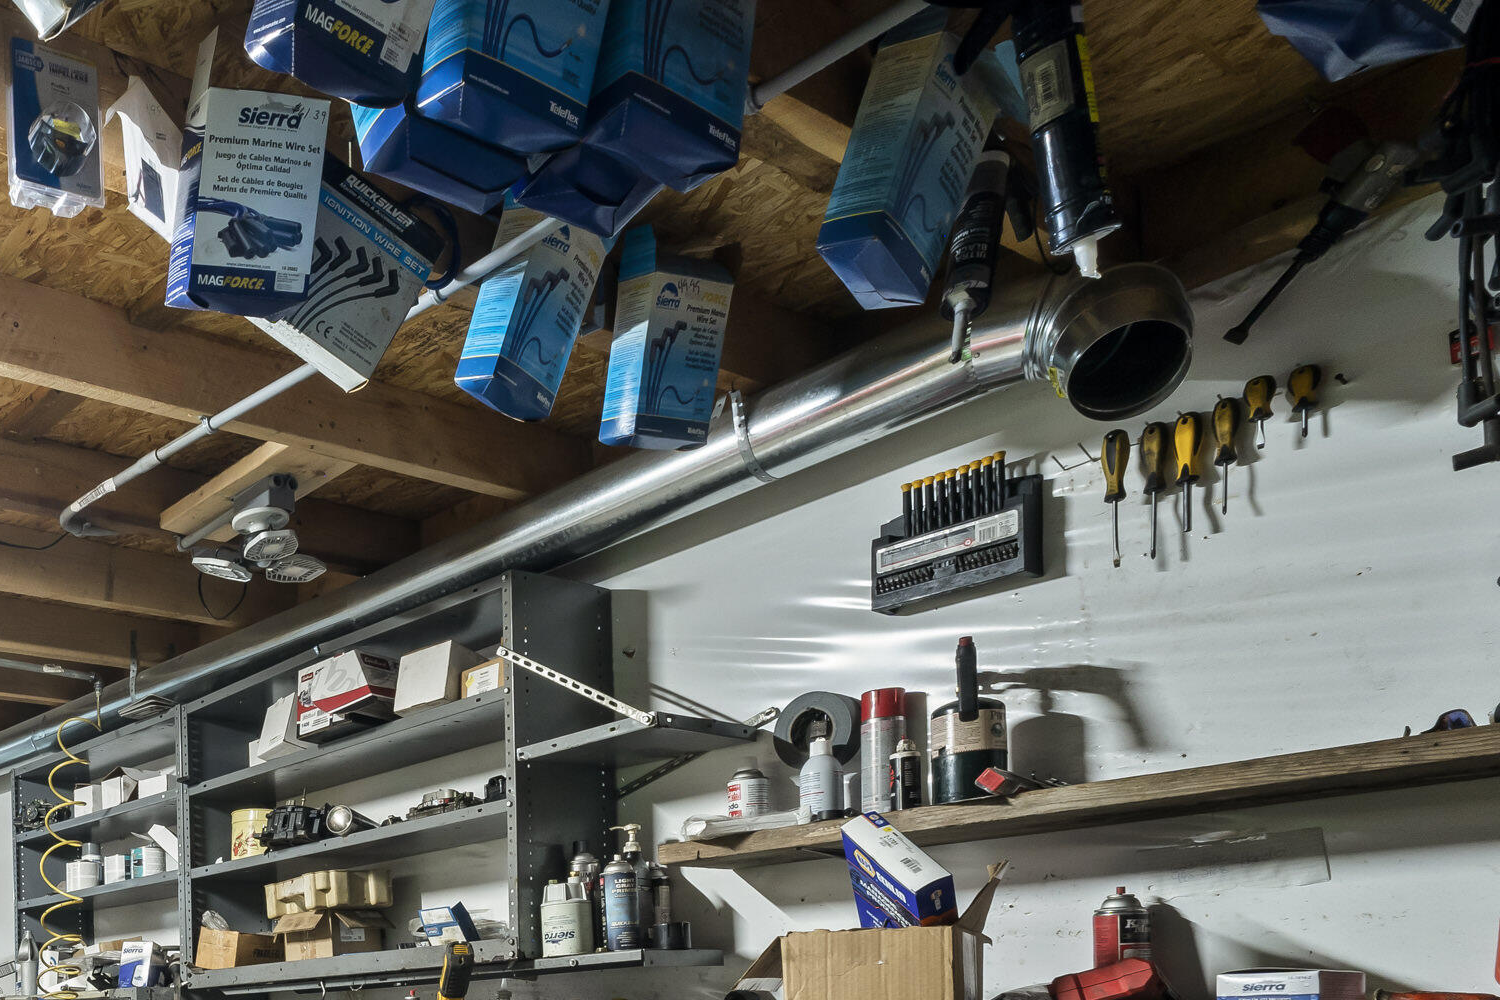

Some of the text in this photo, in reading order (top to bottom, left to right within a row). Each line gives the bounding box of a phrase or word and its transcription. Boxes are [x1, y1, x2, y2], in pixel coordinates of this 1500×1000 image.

[304, 3, 375, 55] MAGFORCE
[549, 100, 580, 125] Teleflex
[209, 134, 321, 155] Premium Marine Wire Set
[708, 123, 737, 148] Teleflex
[215, 151, 236, 161] Juego
[249, 153, 272, 162] Cables
[274, 156, 302, 166] Marinos
[303, 159, 312, 167] de
[236, 161, 291, 174] Óptima Calidad
[213, 184, 308, 200] Marins de Première Qualité
[217, 175, 303, 191] Set de Câbles de Bougies
[346, 173, 414, 228] QUICKSILVER
[324, 195, 426, 275] IGNITION WIRE SET
[197, 274, 265, 290] MAGFORCE
